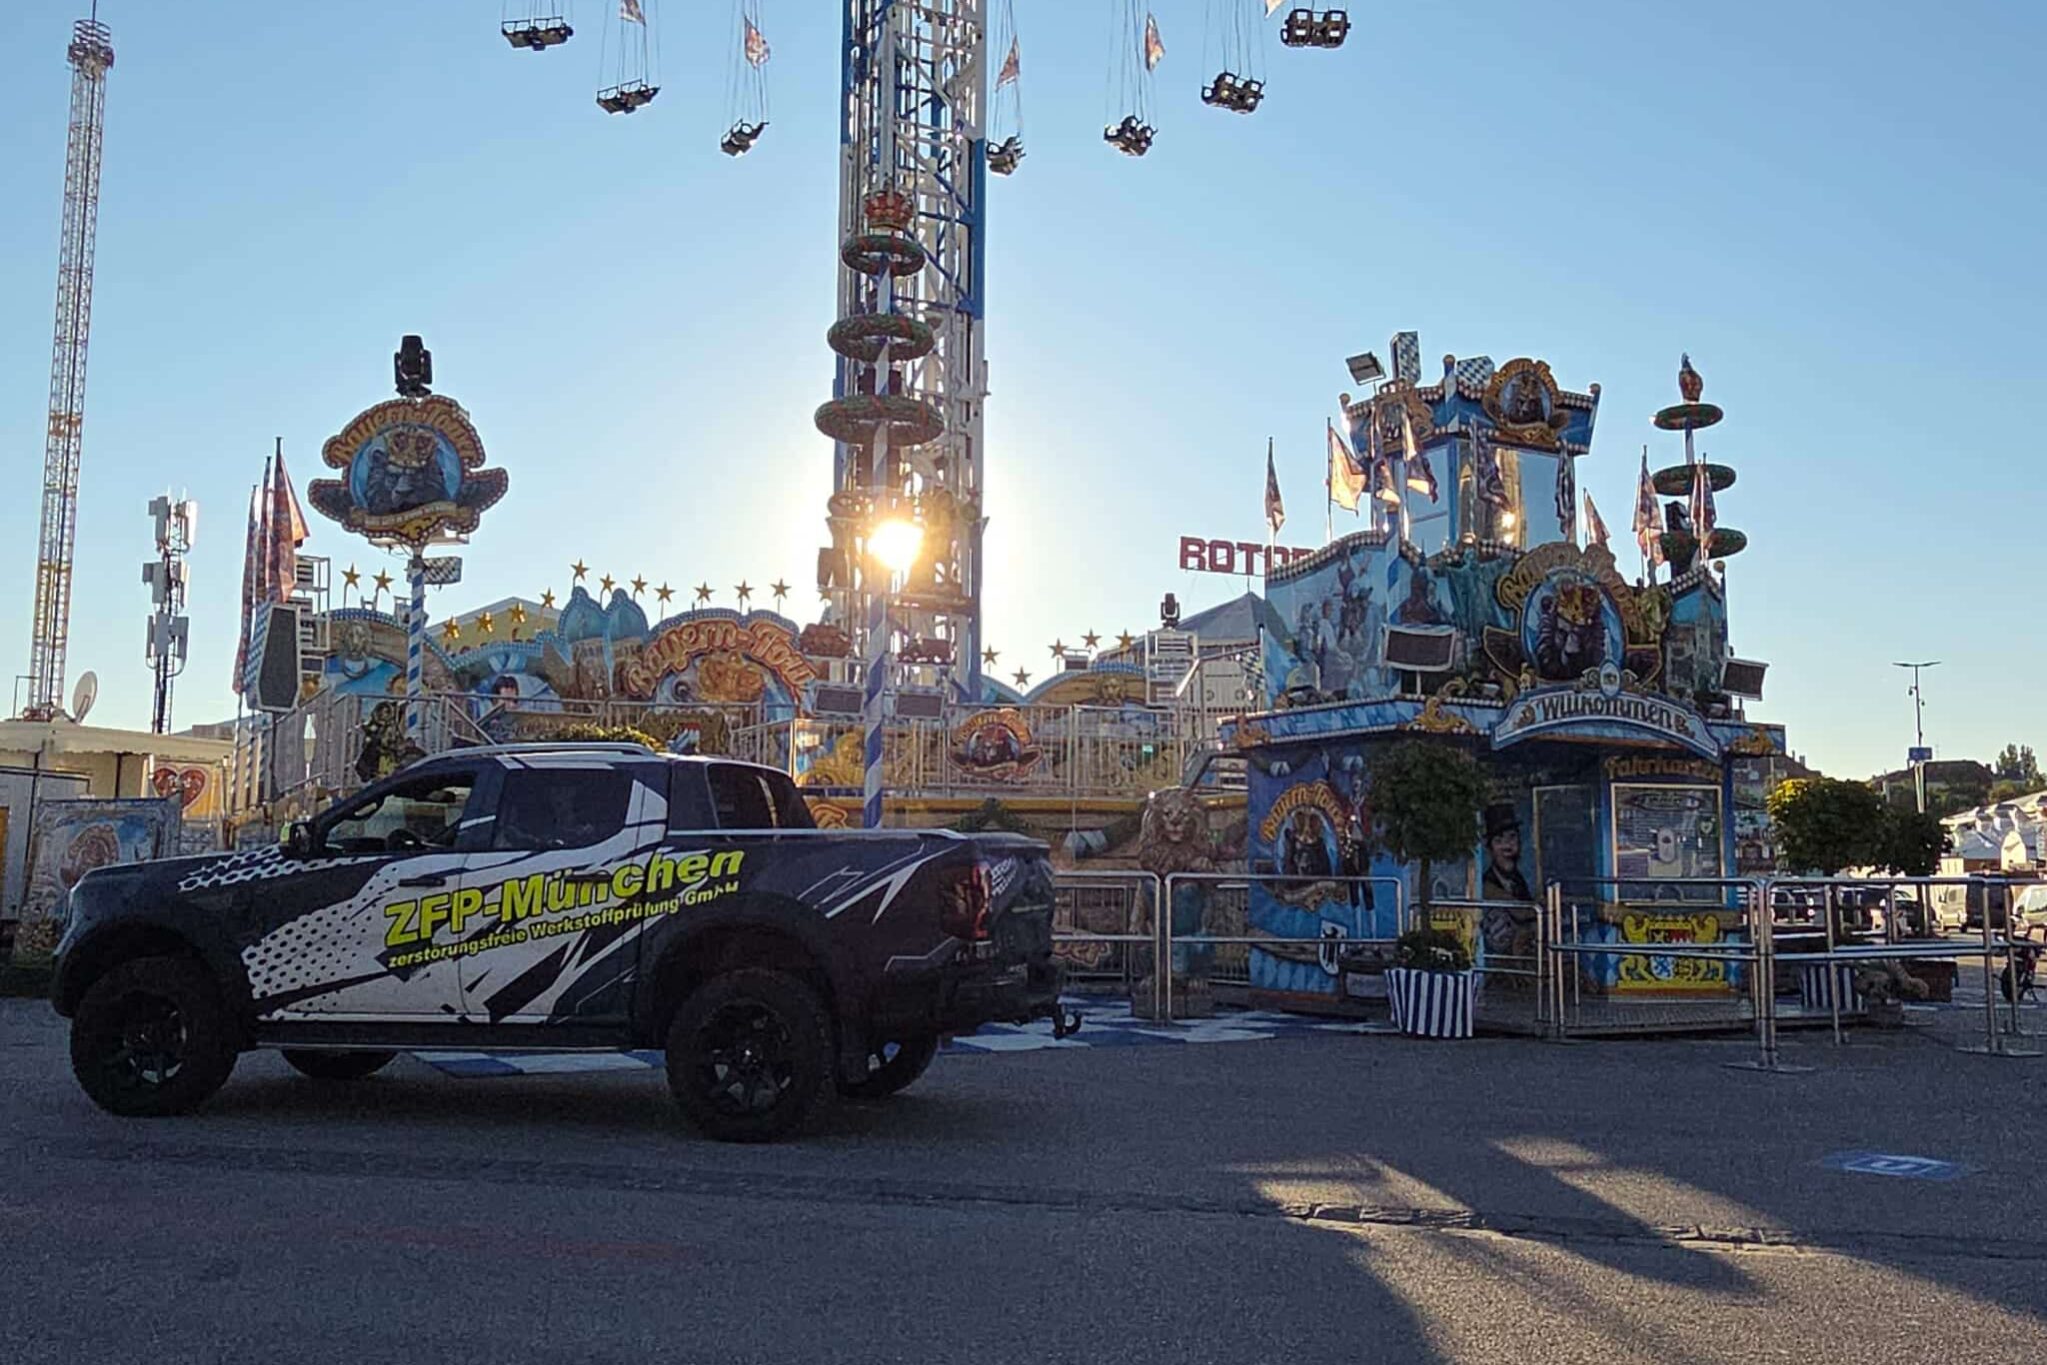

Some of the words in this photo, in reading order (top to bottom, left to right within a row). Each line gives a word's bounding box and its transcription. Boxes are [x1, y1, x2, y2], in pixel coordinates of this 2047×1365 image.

[384, 848, 746, 948] ZFP-München
[388, 926, 527, 969] zerstörungsfreie
[530, 897, 681, 938] Werkstoffprüfung
